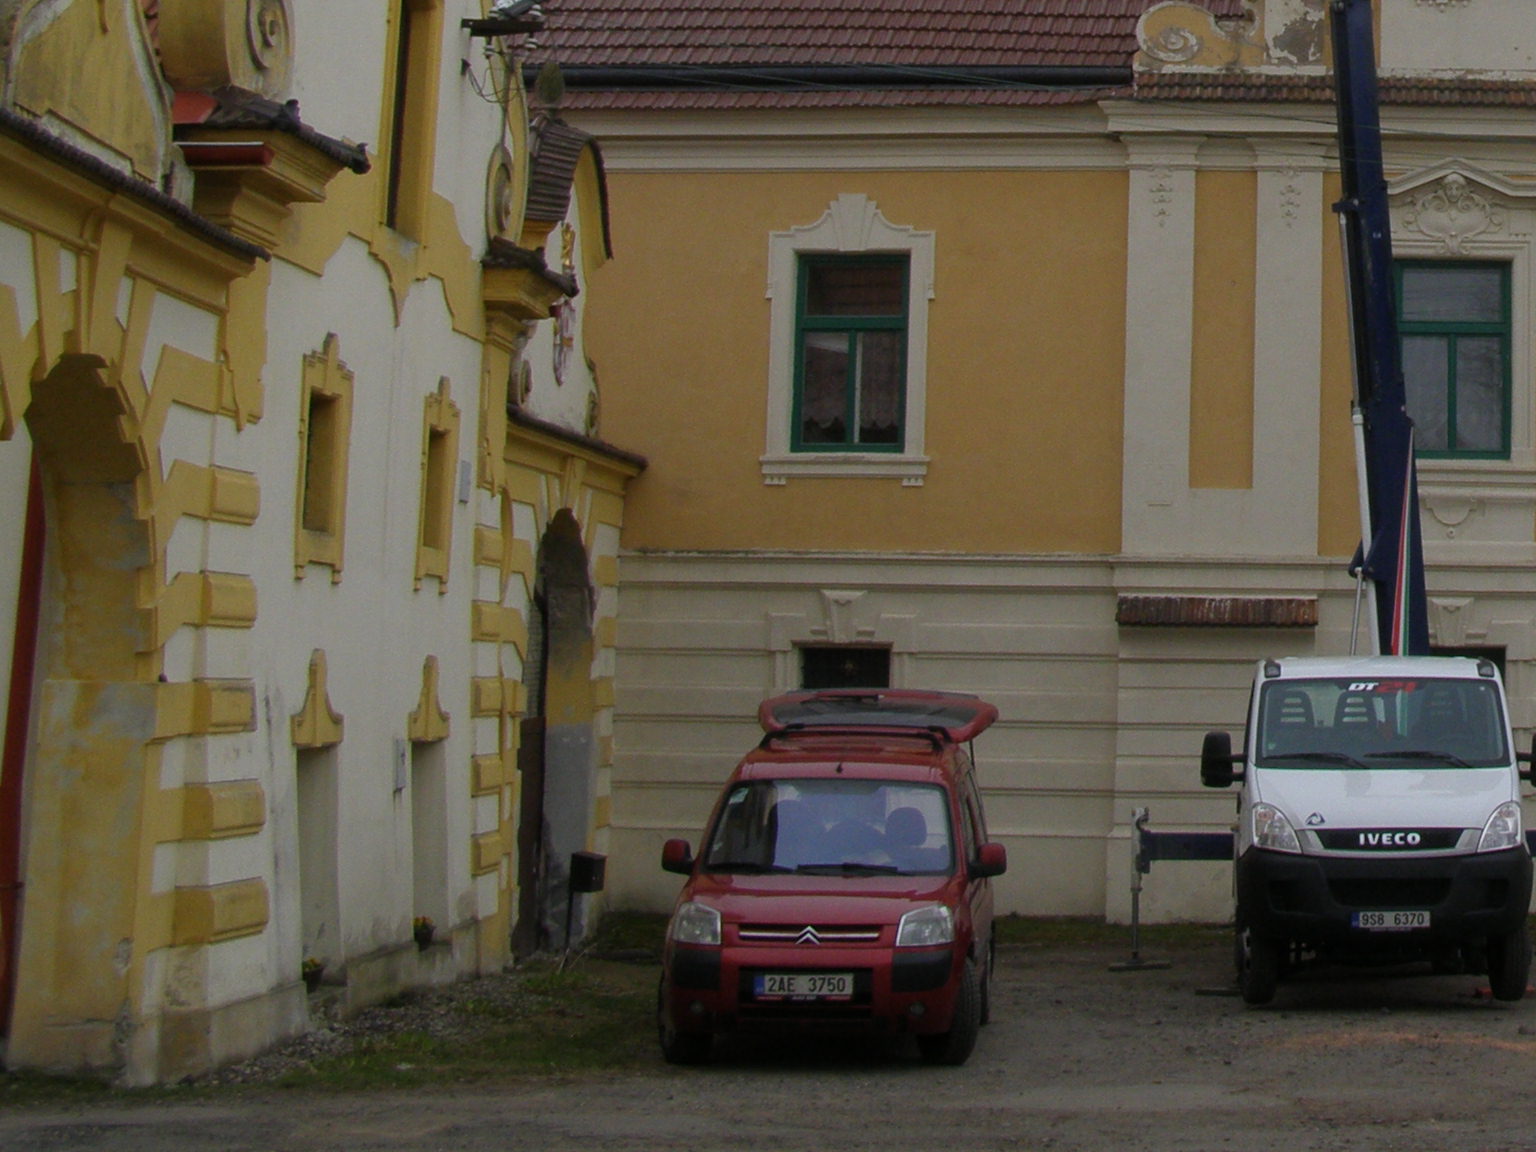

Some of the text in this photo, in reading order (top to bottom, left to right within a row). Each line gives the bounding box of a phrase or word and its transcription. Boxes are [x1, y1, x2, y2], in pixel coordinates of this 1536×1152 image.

[1359, 832, 1421, 846] IVECO
[1361, 913, 1385, 926] 9S8
[1394, 913, 1425, 926] 6370
[767, 976, 796, 993] 2AE
[807, 976, 846, 993] 3750
